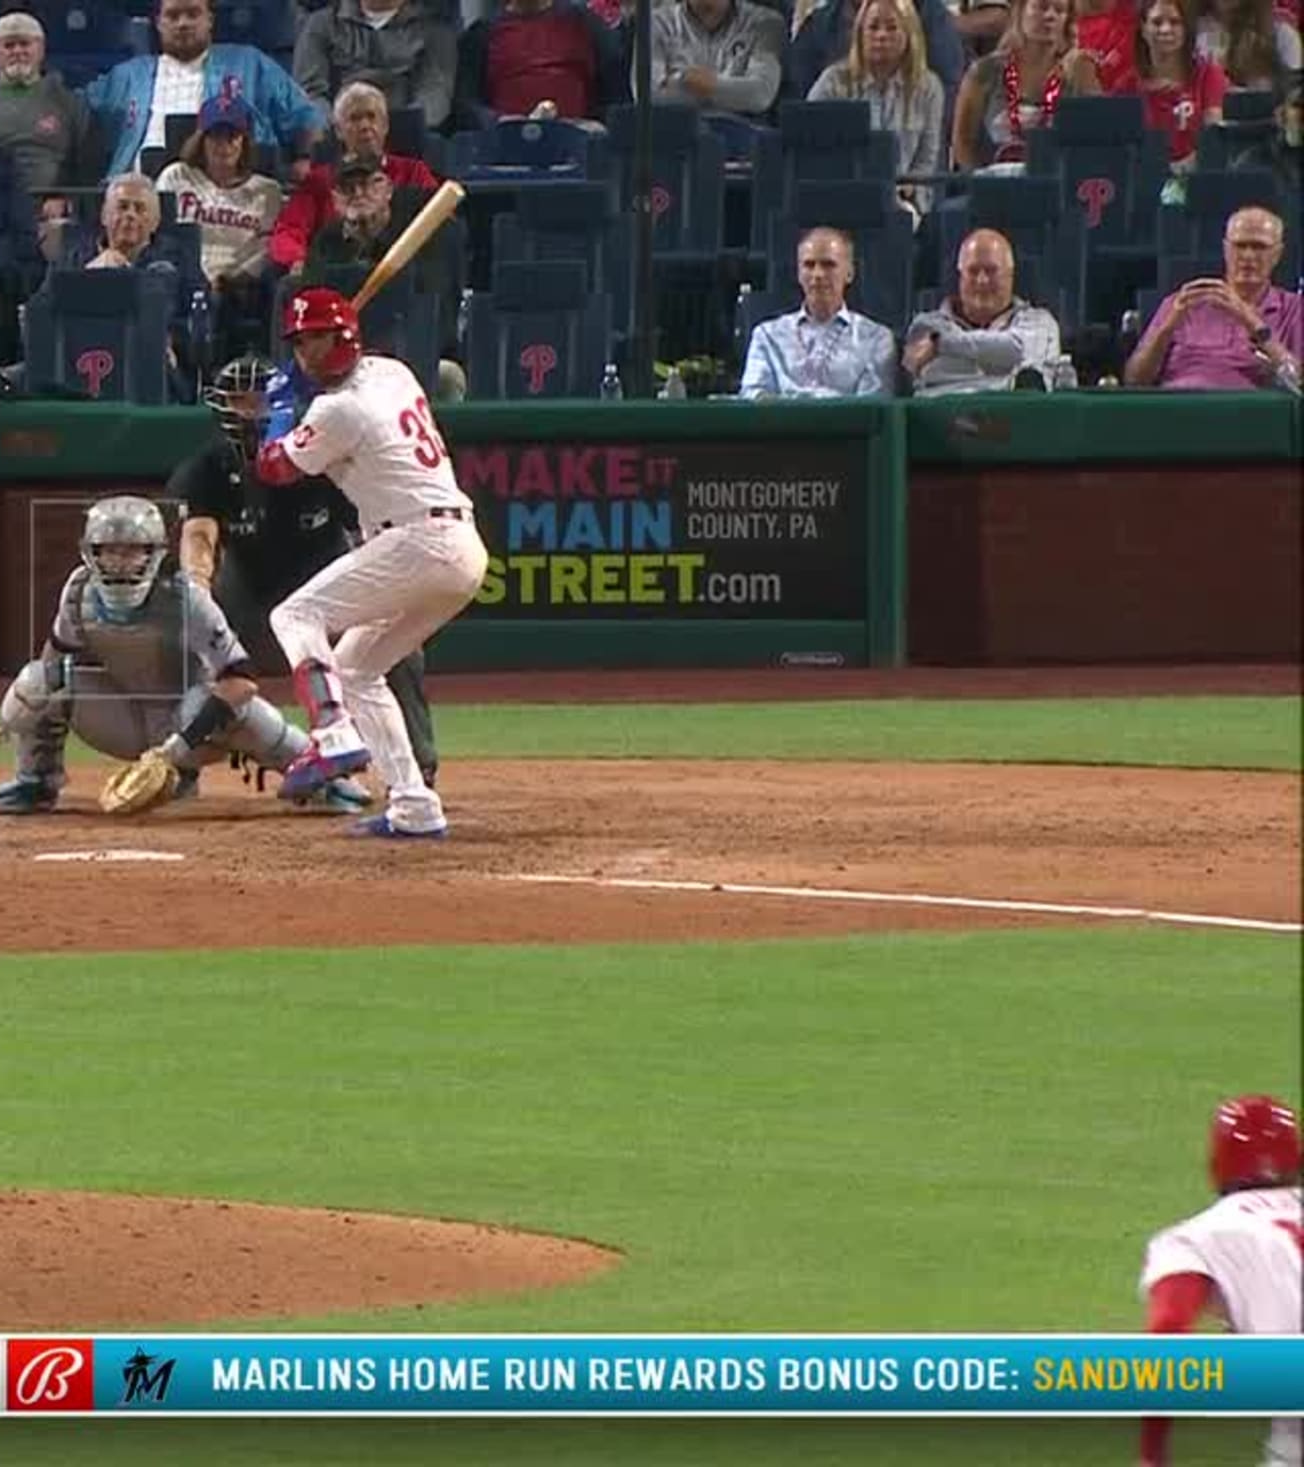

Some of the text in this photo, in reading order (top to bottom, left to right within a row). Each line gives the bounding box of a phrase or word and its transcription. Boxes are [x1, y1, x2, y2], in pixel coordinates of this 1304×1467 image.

[458, 449, 677, 497] MAKE IT
[687, 481, 840, 507] MONTGOMERY
[508, 502, 672, 549] MAIN
[687, 513, 818, 540] COUNTY, PA
